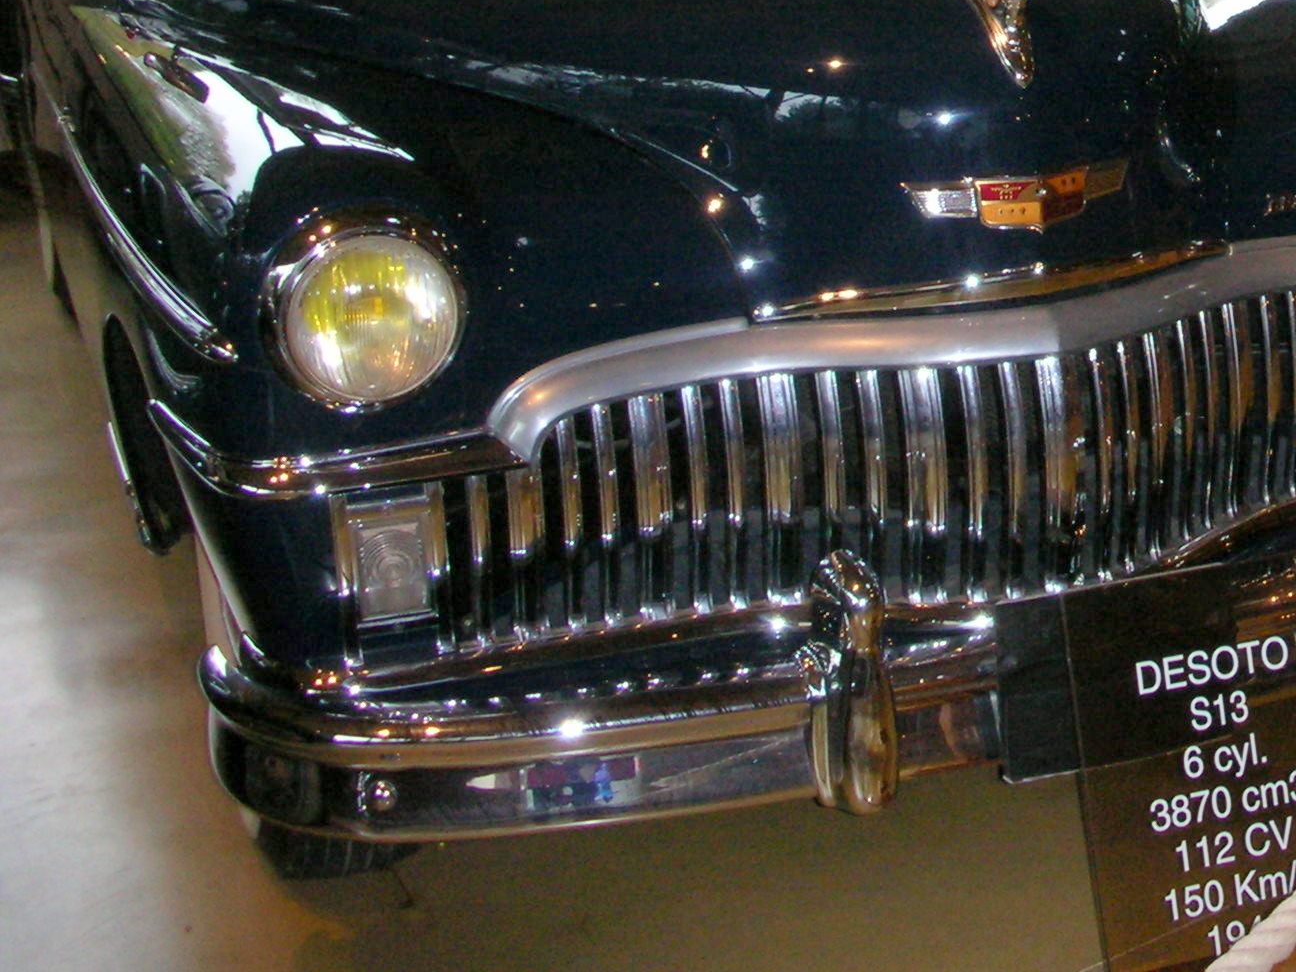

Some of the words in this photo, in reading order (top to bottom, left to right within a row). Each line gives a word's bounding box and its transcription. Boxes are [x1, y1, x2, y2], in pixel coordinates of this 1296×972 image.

[1135, 635, 1289, 696] DESOTO
[1190, 690, 1249, 731] S13
[1183, 745, 1204, 778] 6
[1213, 733, 1268, 777] cyl.
[1150, 786, 1232, 832] 3870
[1175, 831, 1236, 872] 112
[1245, 816, 1293, 856] CV
[1165, 879, 1224, 921] 150
